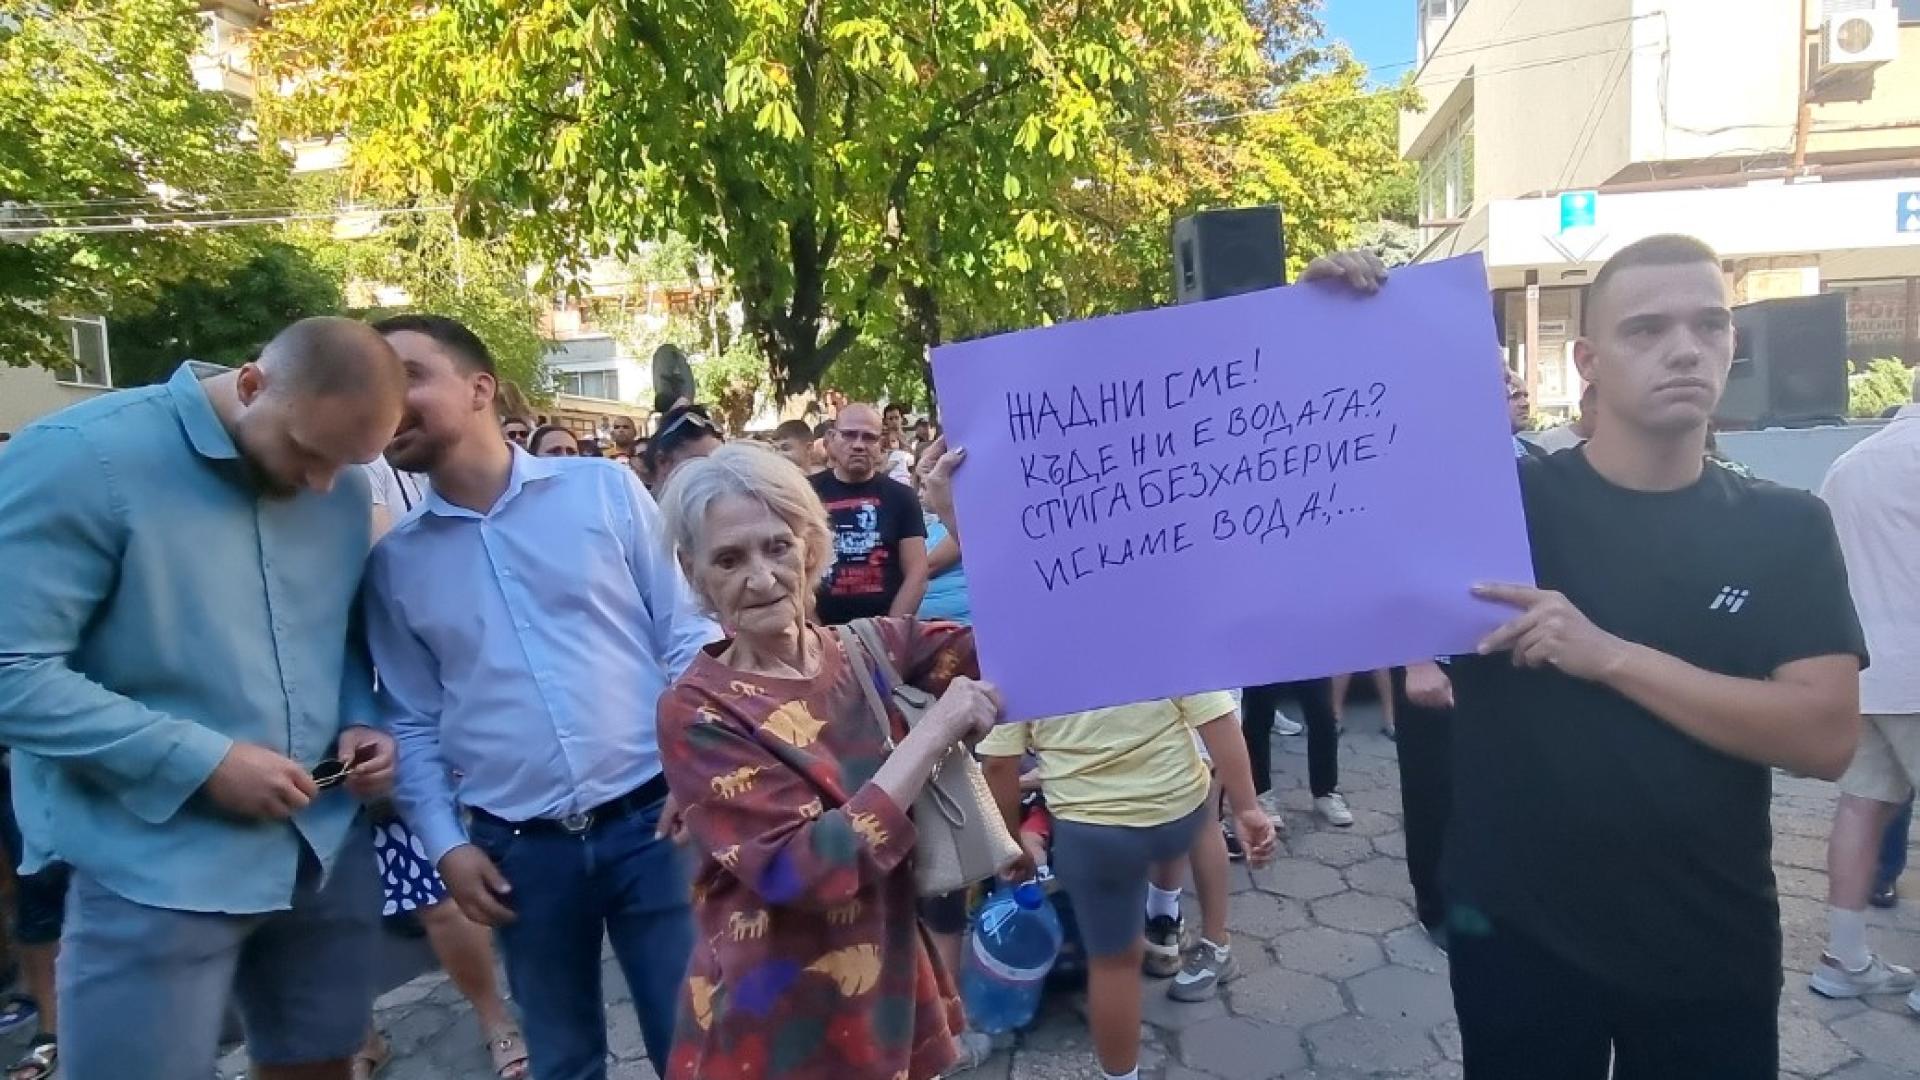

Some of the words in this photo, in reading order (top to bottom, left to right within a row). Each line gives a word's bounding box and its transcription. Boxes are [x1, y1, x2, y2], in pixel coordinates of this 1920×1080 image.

[1006, 379, 1146, 443] ЖАДНИ
[1165, 347, 1260, 410] СМЕ!
[1020, 443, 1119, 497] КЪДЕ
[1131, 431, 1176, 467] НИ
[1194, 417, 1216, 448] Е
[1022, 481, 1131, 540] СТИГА
[1034, 522, 1194, 591] ИСКАМЕ
